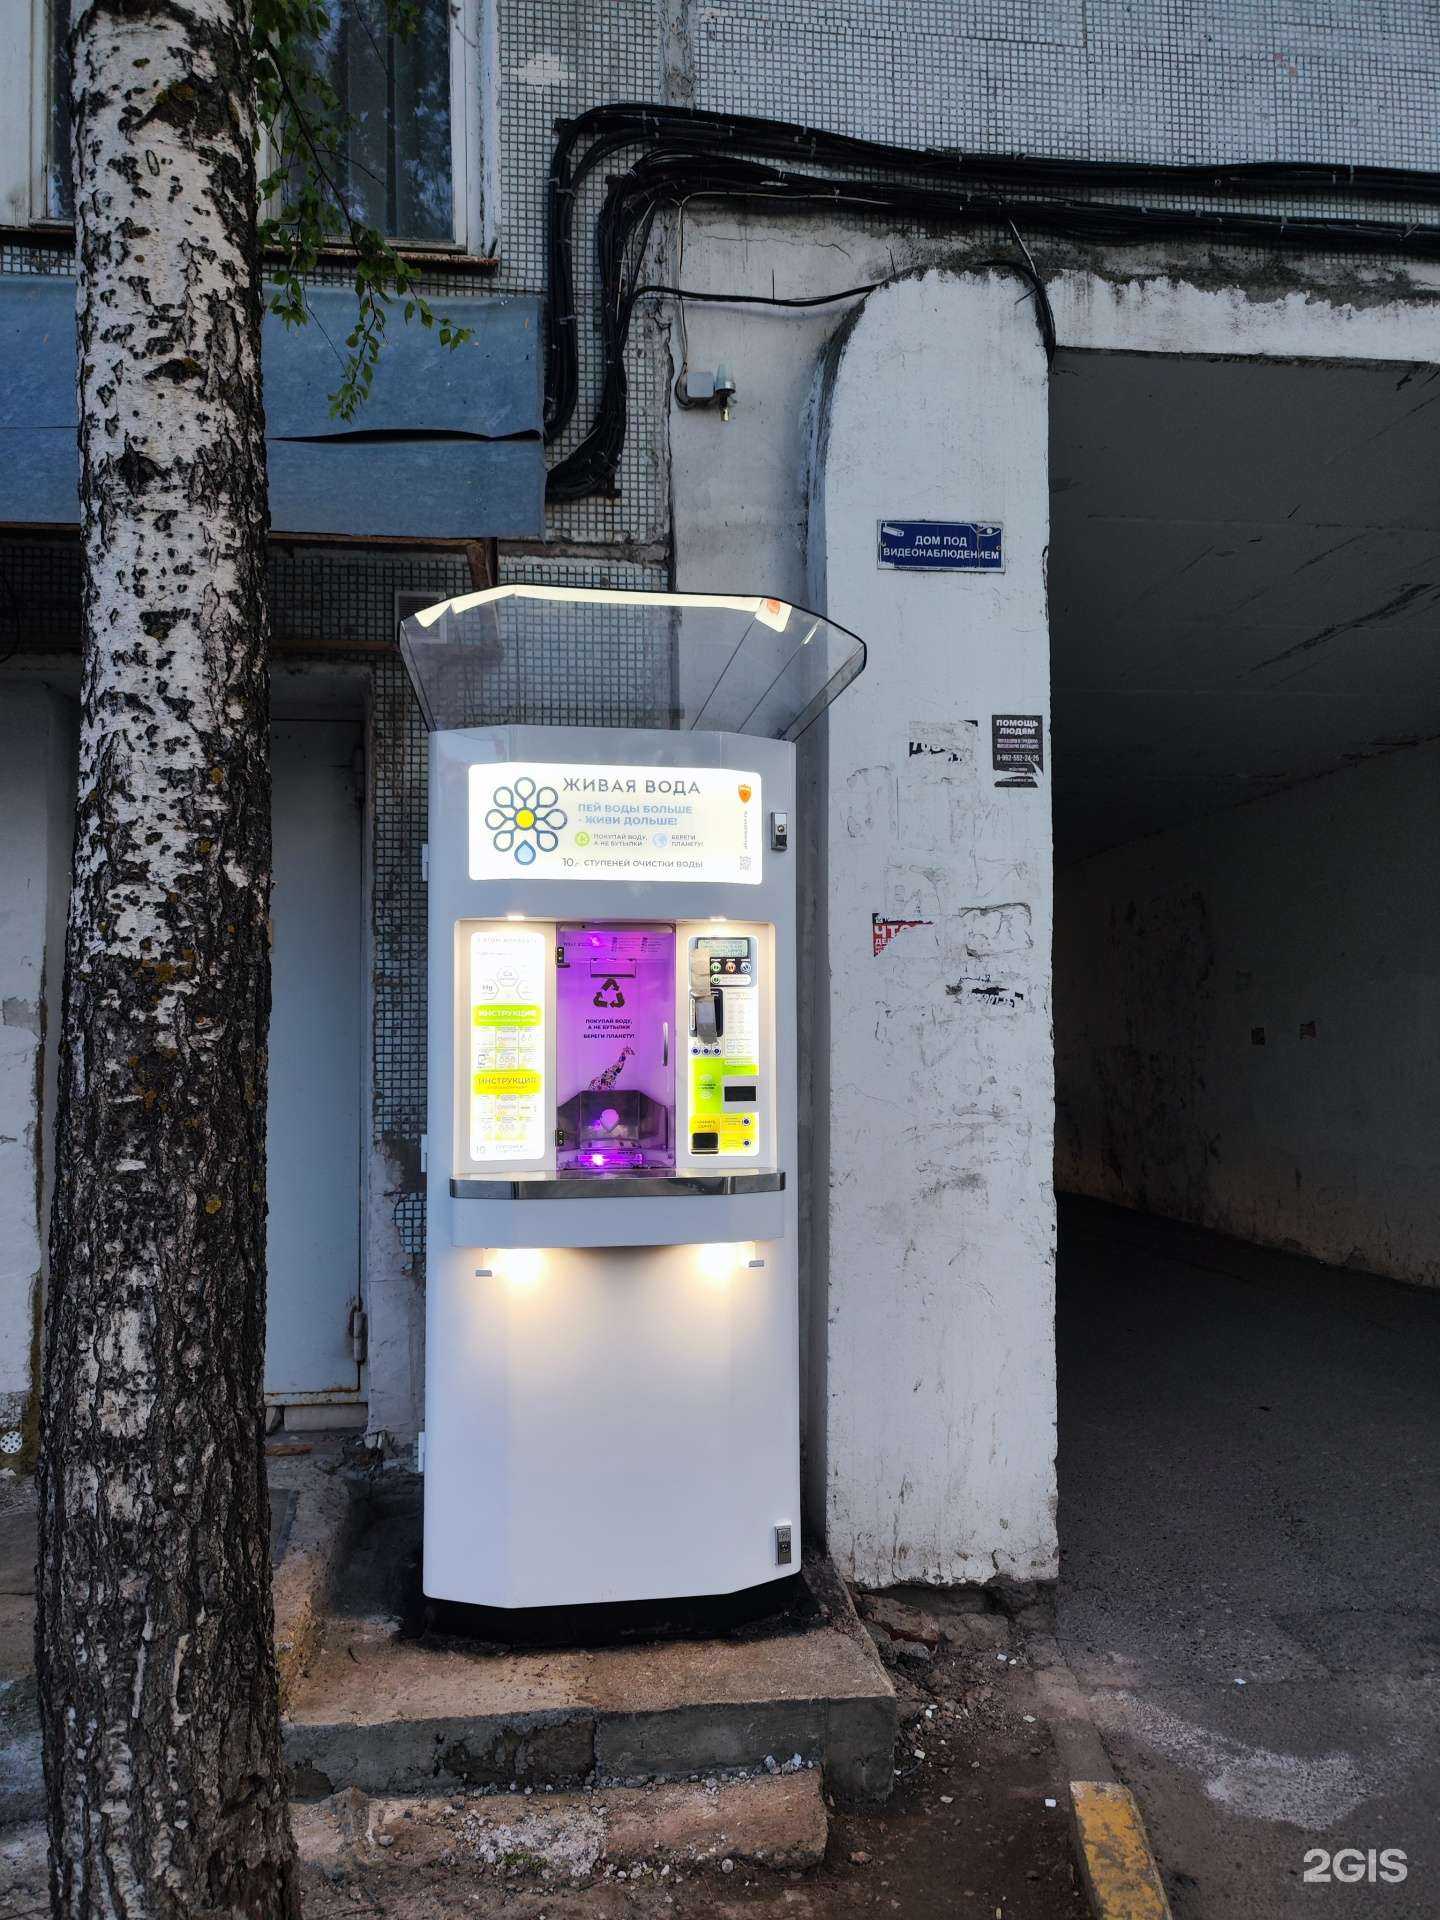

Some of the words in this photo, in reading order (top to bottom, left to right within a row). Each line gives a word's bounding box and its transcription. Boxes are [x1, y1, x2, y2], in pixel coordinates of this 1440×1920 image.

[915, 536, 940, 546] ДОМ
[943, 536, 968, 547] ПОД
[883, 547, 1000, 560] ВИДЕОНАБЛЮДЕНИЕМ
[996, 719, 1039, 728] ПОМОЩЬ
[999, 728, 1036, 736] ЛЮДЯМ
[563, 777, 637, 793] ЖИВАЯ
[645, 779, 701, 796] ВОДА
[578, 802, 602, 812] ПЕЙ
[604, 803, 640, 814] ВОДЫ
[642, 804, 693, 815] БОЛЬШЕ
[585, 815, 621, 825] ЖИВИ
[623, 815, 678, 826] ДОЛЬШЕ!
[593, 832, 627, 841] ПОКУПАЙ
[583, 858, 631, 868] СТУПЕНЕЙ
[632, 859, 674, 868] ОЧИСТКИ
[676, 860, 704, 869] ВОДЫ
